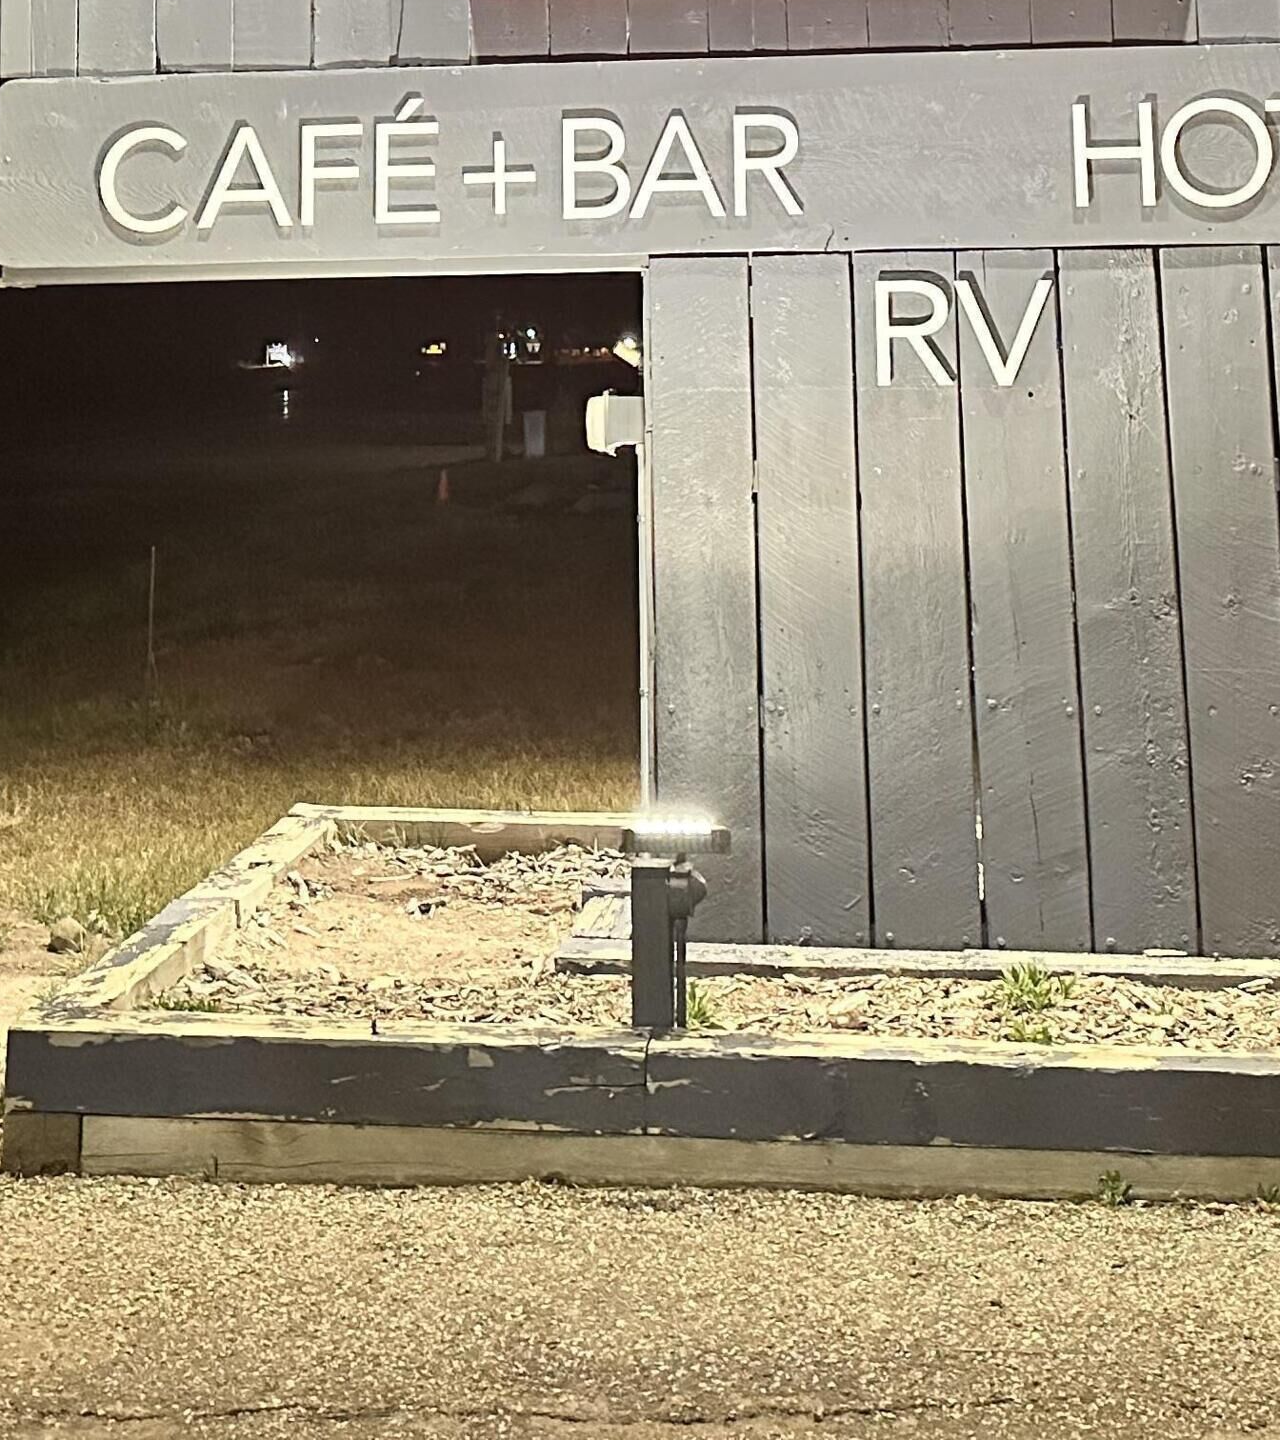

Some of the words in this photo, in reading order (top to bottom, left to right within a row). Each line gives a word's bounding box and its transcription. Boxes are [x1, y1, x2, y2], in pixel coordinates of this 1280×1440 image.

[97, 97, 442, 234] CAFÉ
[561, 112, 805, 221] BAR
[873, 277, 1054, 388] RV
